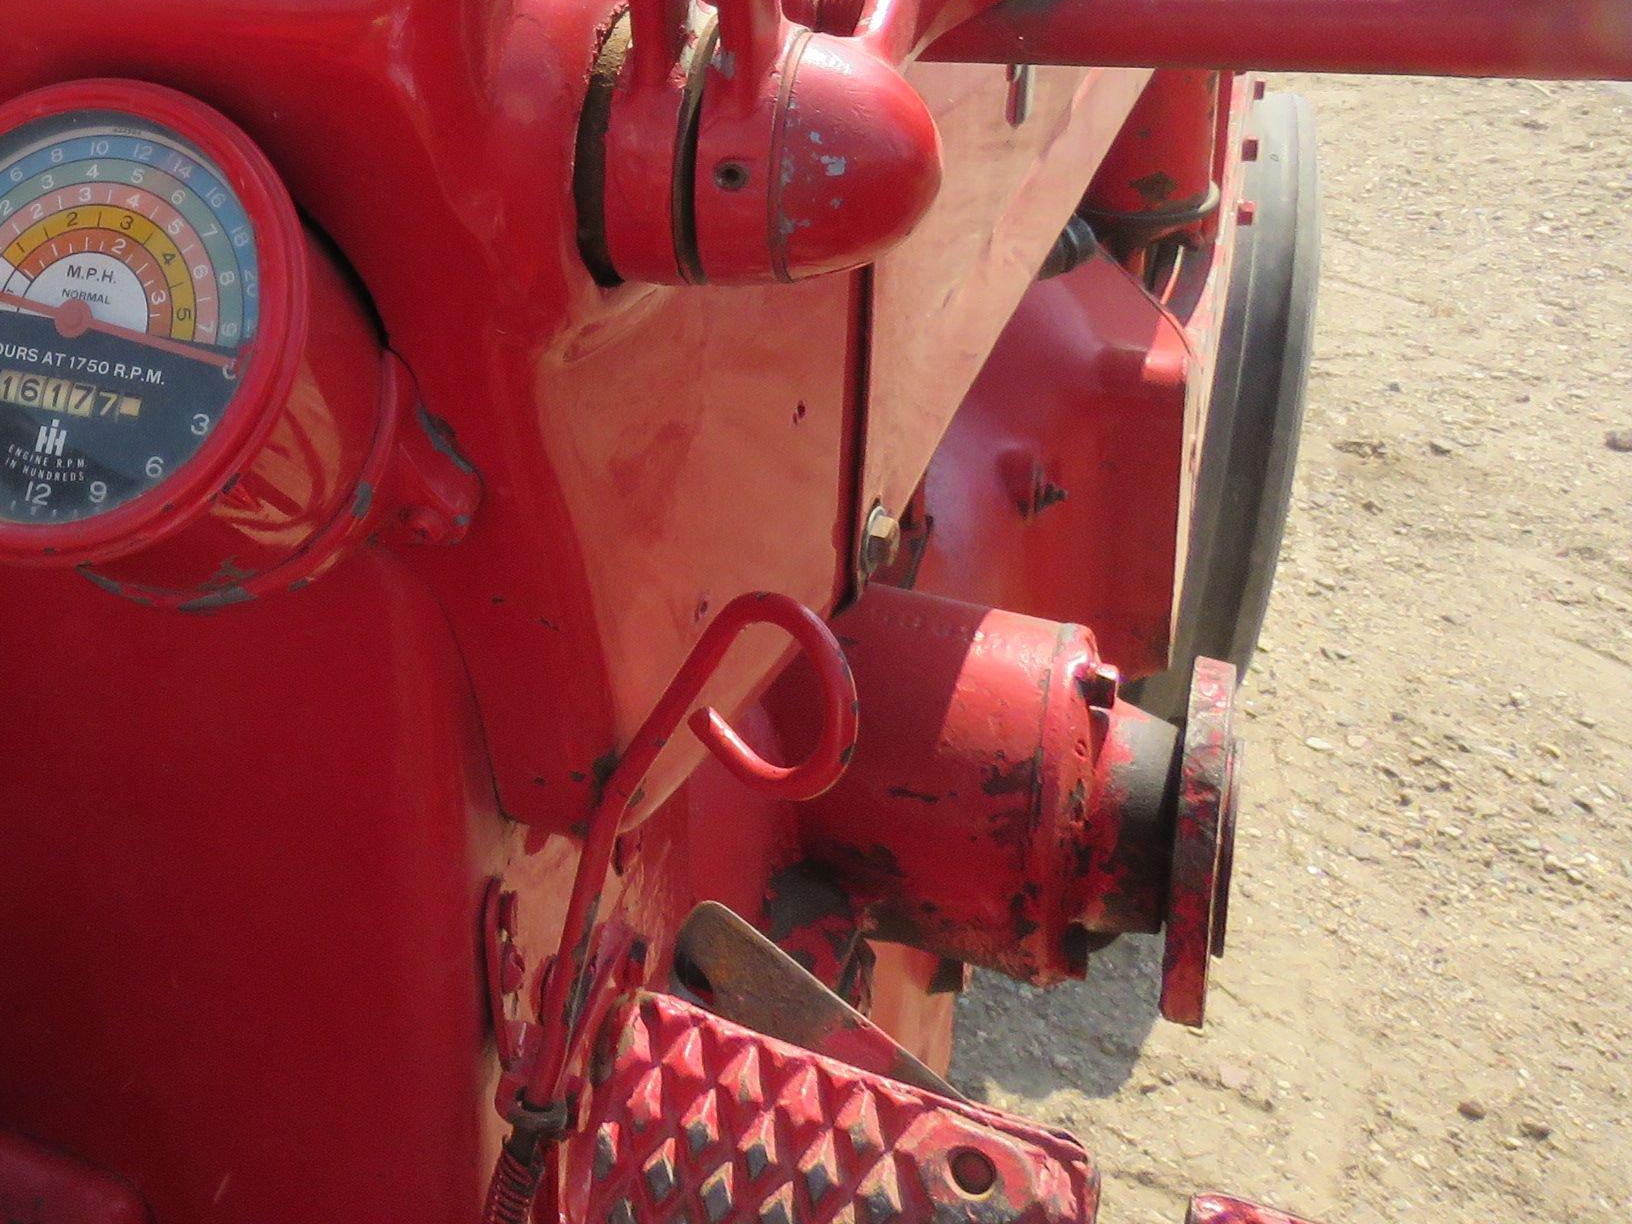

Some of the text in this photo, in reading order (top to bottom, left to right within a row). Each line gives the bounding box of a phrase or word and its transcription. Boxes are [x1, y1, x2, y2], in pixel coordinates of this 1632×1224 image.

[78, 187, 92, 202] 3
[126, 194, 140, 208] 4
[10, 167, 23, 182] 6
[50, 148, 63, 163] 8
[90, 140, 109, 156] 10
[132, 142, 153, 160] 12
[173, 159, 193, 178] 14
[204, 187, 225, 208] 16
[230, 226, 249, 247] 18
[244, 269, 256, 298] 20
[30, 203, 44, 219] 2
[168, 218, 184, 234] 5
[0, 163, 238, 337] 2 3 4 5 6 7 8 9
[67, 211, 79, 226] 2
[120, 214, 134, 230] 3
[163, 252, 177, 265] 4
[176, 307, 191, 321] 5
[68, 263, 117, 284] M.P.H.
[111, 238, 126, 252] 2
[151, 289, 166, 304] 3
[193, 264, 208, 279] 6
[62, 288, 111, 306] NORMAL
[197, 321, 215, 335] 7
[41, 351, 67, 367] AT
[69, 356, 110, 375] 1750
[113, 363, 165, 385] R.P.M.
[190, 413, 210, 436] 3
[8, 444, 49, 467] ENGINE
[145, 456, 164, 478] 6
[4, 457, 85, 482] IN HUNDREDS
[25, 480, 52, 506] 12
[89, 480, 107, 503] 9
